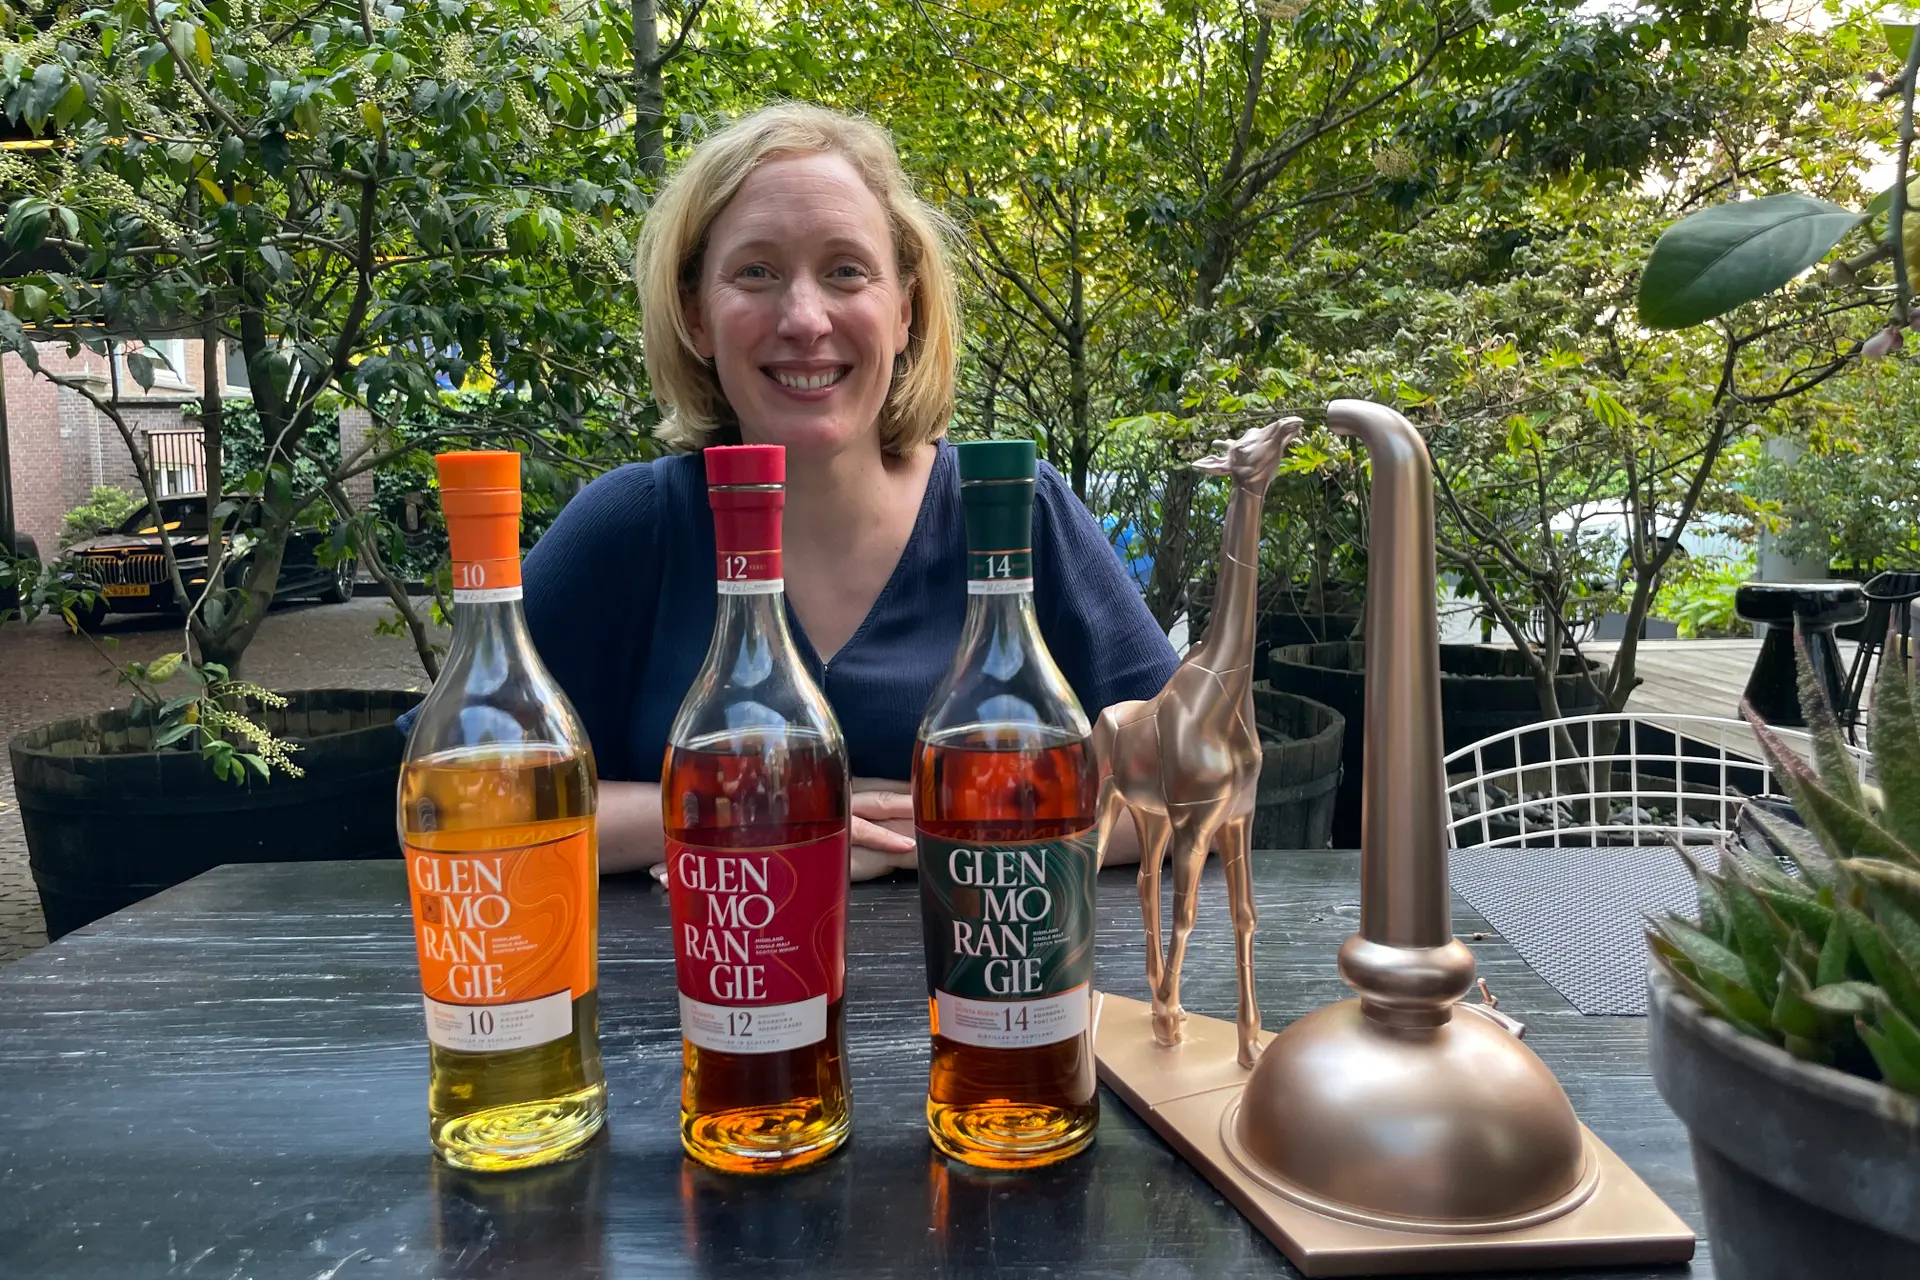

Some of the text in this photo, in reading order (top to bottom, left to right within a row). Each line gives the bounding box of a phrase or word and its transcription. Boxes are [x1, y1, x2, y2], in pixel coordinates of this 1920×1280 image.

[462, 564, 485, 587] 10
[725, 556, 747, 579] 12
[986, 555, 1012, 578] 14
[415, 856, 503, 893] GLEN
[678, 852, 769, 893] GLEN
[949, 848, 1048, 887] GLEN
[442, 894, 511, 929] MO
[707, 893, 775, 929] MO
[984, 887, 1052, 922] MO
[422, 926, 487, 964] RAN
[683, 924, 750, 964] RAN
[952, 920, 1028, 957] RAN
[448, 964, 507, 999] GIE
[709, 965, 767, 1000] GIE
[984, 958, 1043, 994] GIE
[467, 1010, 494, 1035] 10
[727, 1011, 753, 1036] 12
[1003, 1006, 1029, 1032] 14
